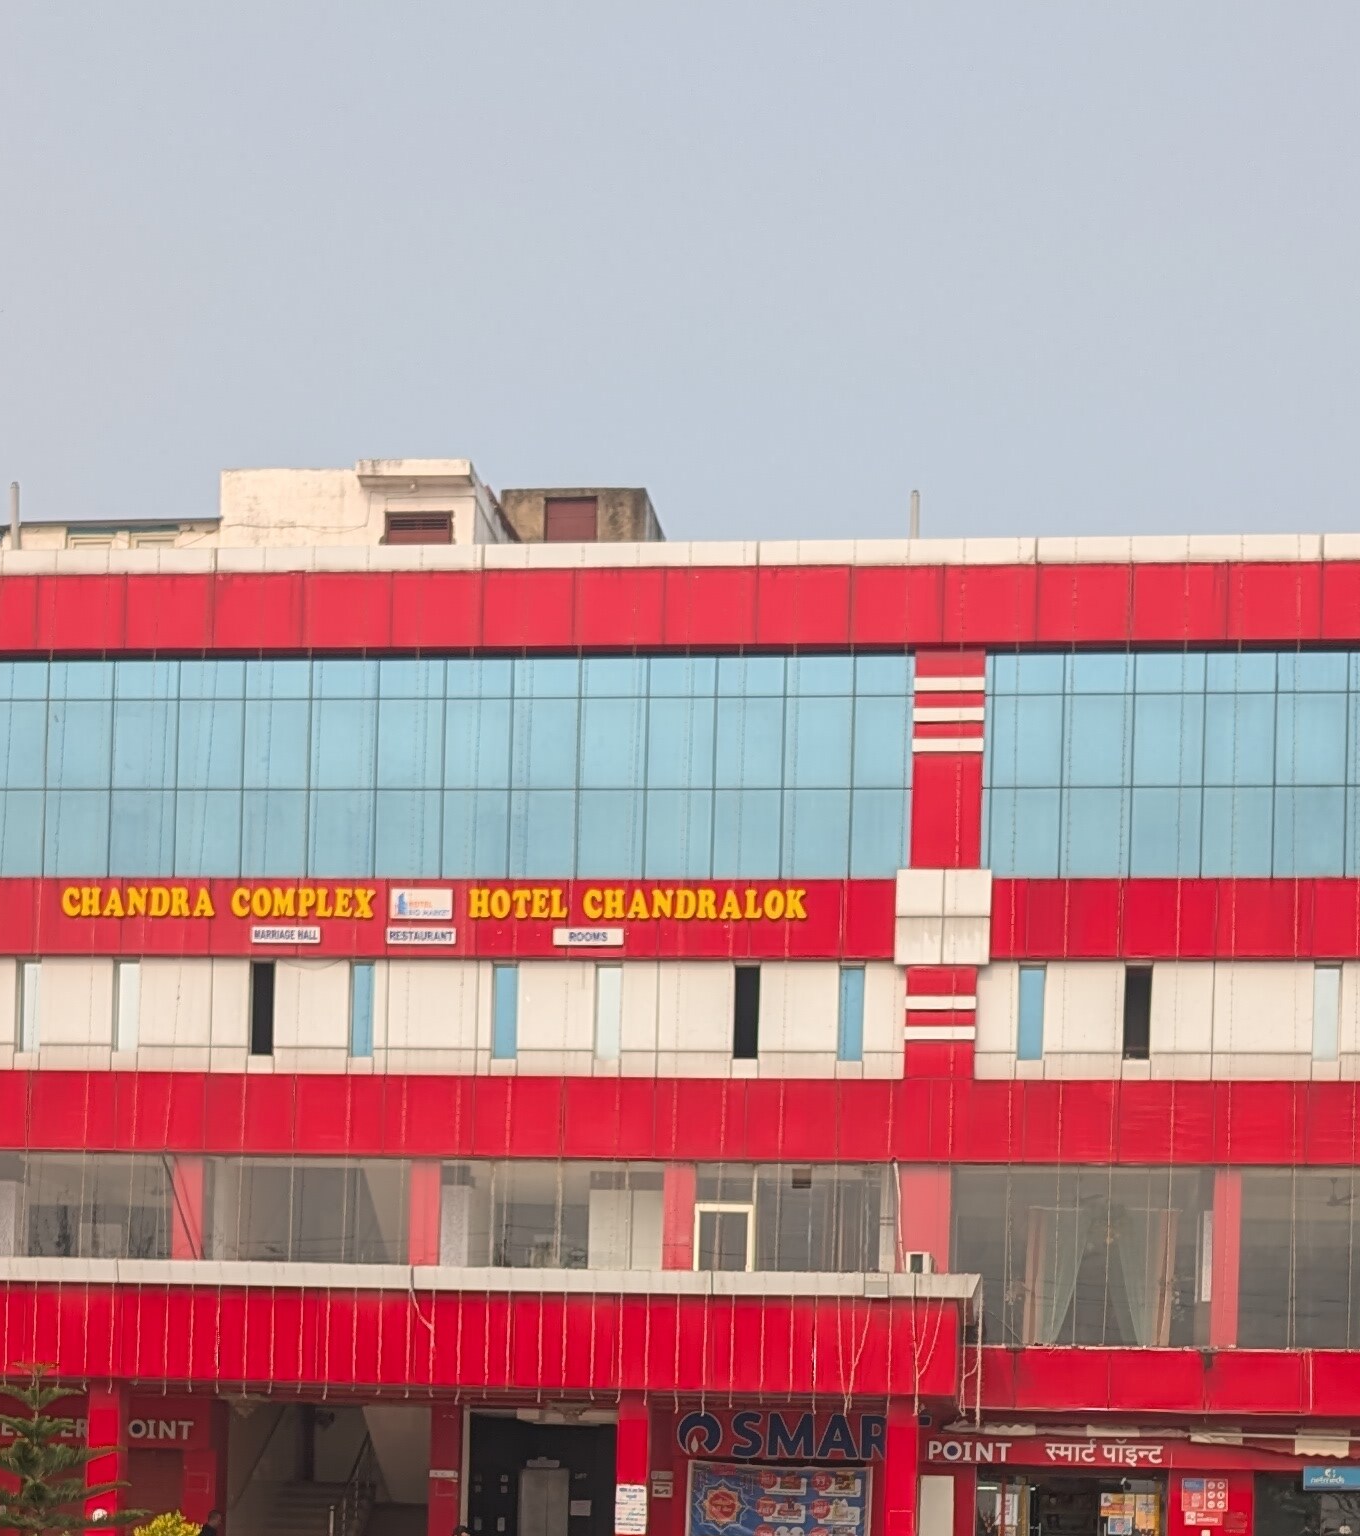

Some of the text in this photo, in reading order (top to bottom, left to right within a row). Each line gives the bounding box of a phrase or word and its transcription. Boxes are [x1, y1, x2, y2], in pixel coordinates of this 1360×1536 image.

[61, 887, 376, 918] CHANDRA COMPLEX
[468, 888, 808, 919] HOTEL CHANDRALOK
[254, 930, 318, 941] MARRIAGE HALL
[389, 930, 453, 941] RESTAURANT
[569, 931, 608, 942] ROOMS
[128, 1418, 194, 1440] OINT
[731, 1411, 1012, 1462] SMAR POINT
[1045, 1437, 1163, 1466] स्मार्ट पॉइन्ट
